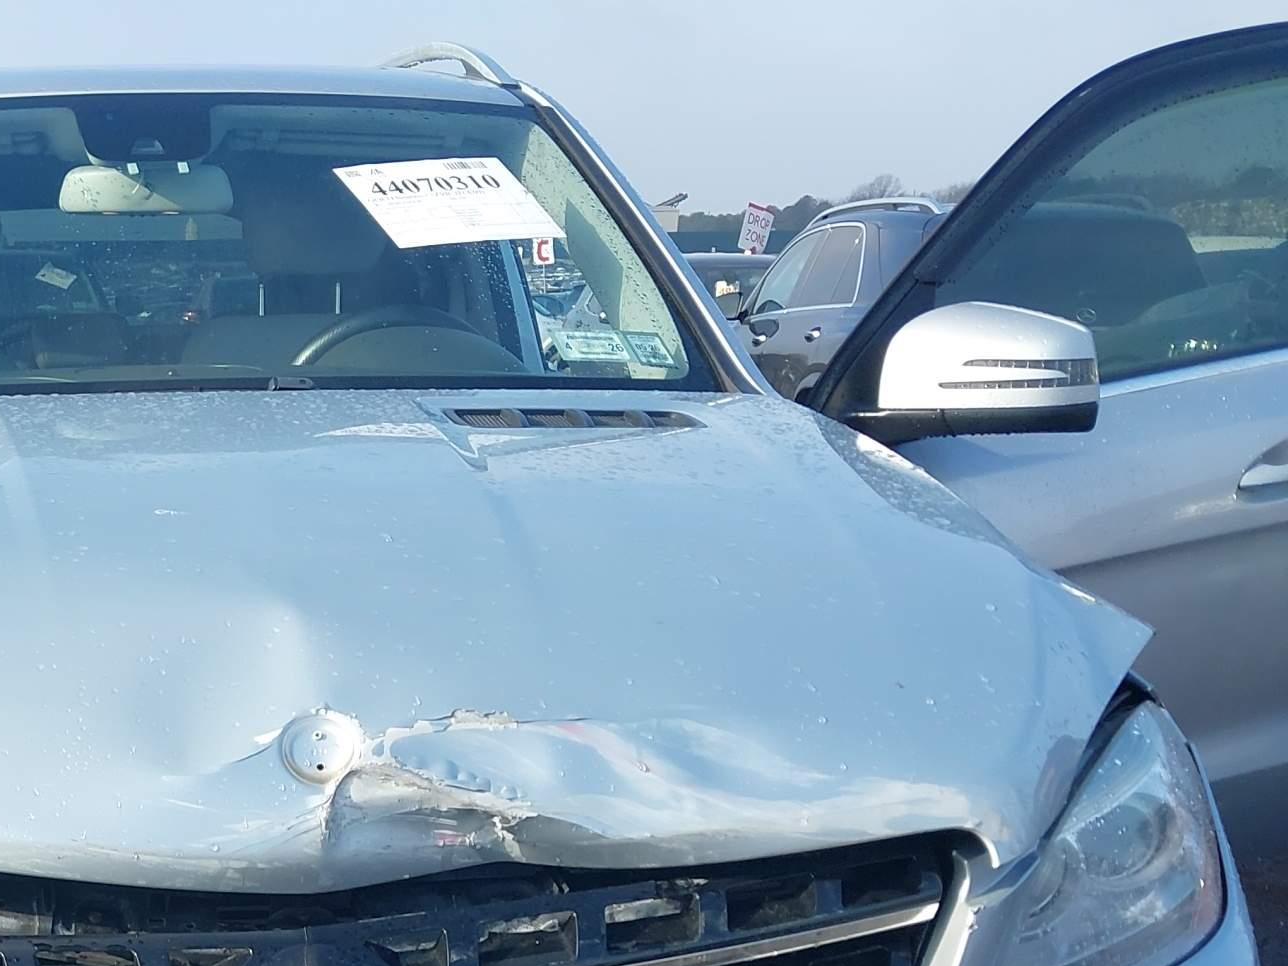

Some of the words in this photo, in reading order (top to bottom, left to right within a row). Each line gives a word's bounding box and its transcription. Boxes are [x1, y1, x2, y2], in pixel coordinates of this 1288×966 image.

[371, 174, 500, 196] 44070310
[747, 211, 770, 229] DROP
[744, 228, 766, 247] ZONE
